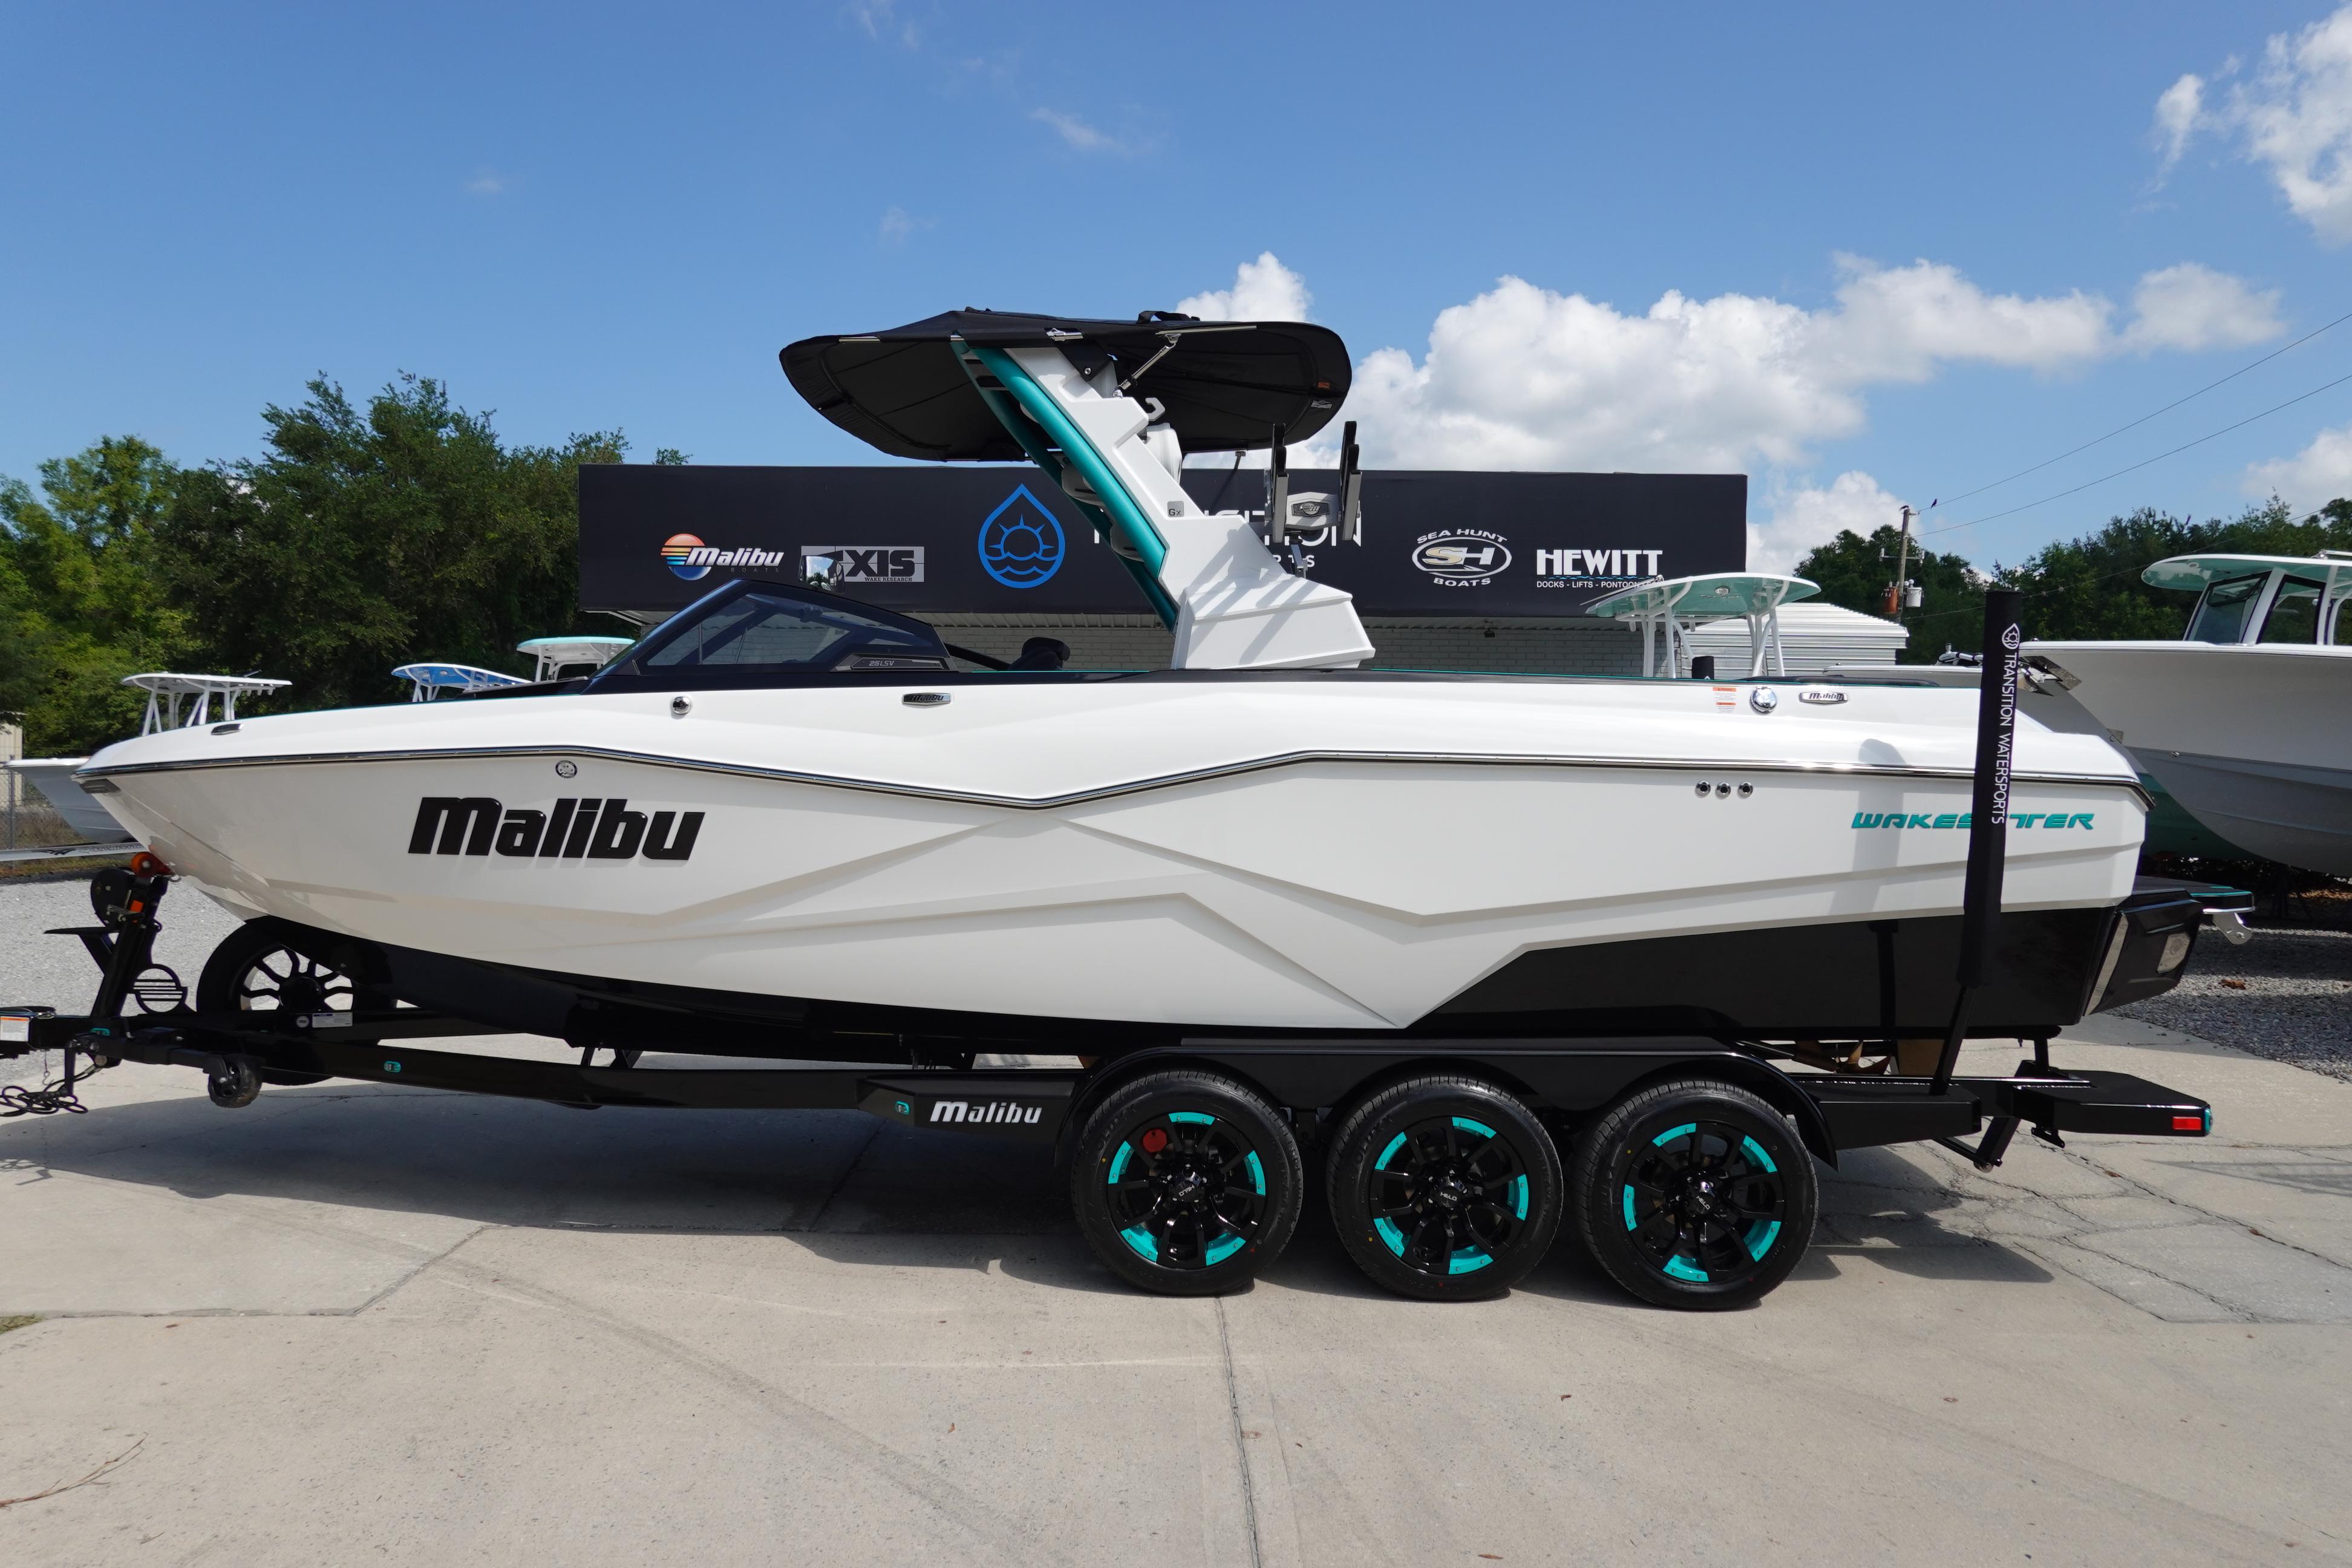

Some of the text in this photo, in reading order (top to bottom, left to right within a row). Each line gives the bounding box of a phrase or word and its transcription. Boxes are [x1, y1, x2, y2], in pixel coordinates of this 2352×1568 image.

[1417, 529, 1508, 544] SEA HUNT
[685, 547, 785, 566] Malibu
[1422, 546, 1495, 565] SH
[1537, 549, 1663, 575] HEWITT
[1433, 578, 1491, 587] BOATS
[1991, 652, 2017, 824] TRANSITION WATERSPORTS
[408, 797, 706, 860] Malibu
[1851, 812, 2094, 830] WAKESTTER
[930, 1101, 1042, 1123] Malibu
